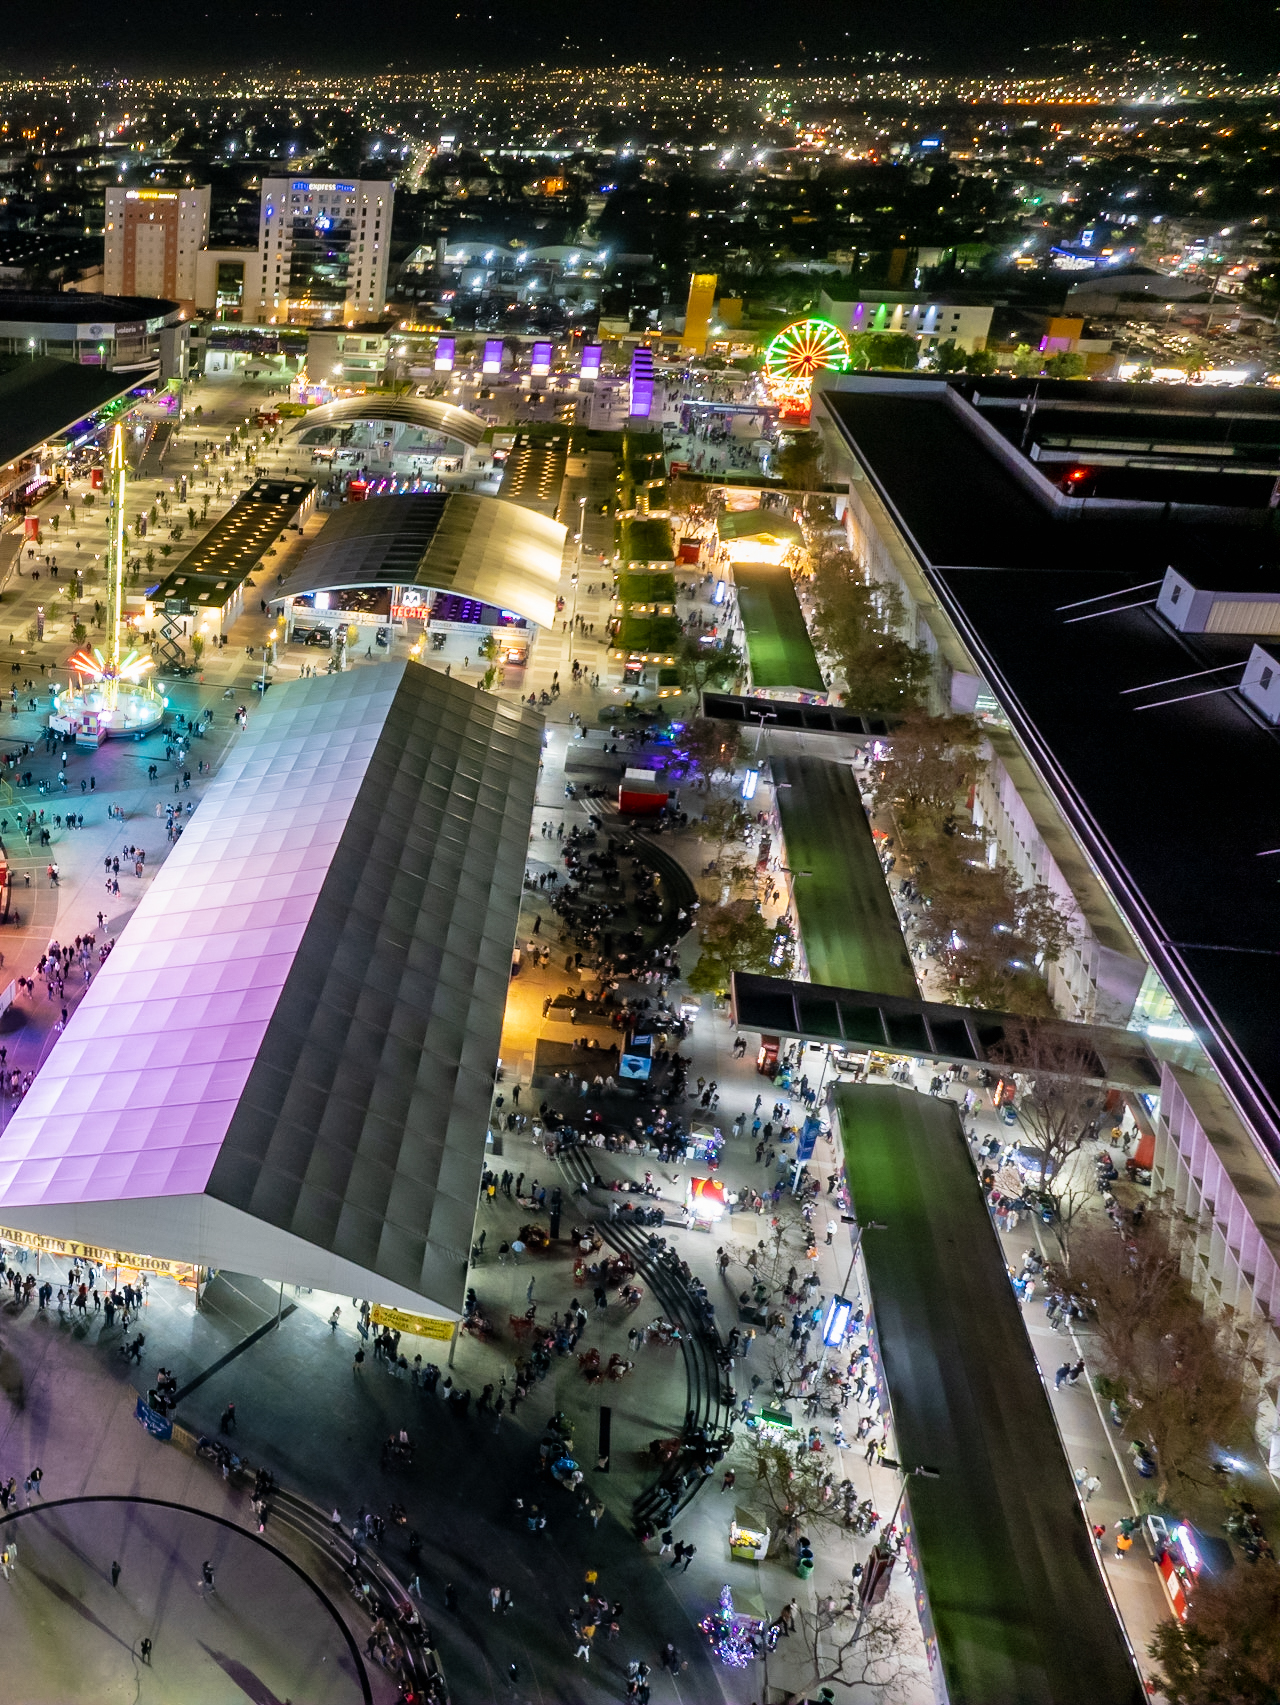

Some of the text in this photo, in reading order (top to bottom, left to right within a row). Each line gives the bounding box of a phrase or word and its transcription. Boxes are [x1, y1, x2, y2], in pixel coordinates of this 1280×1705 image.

[391, 604, 431, 619] TECATE
[69, 1243, 79, 1255] Y
[83, 1243, 171, 1271] HUARACHON
